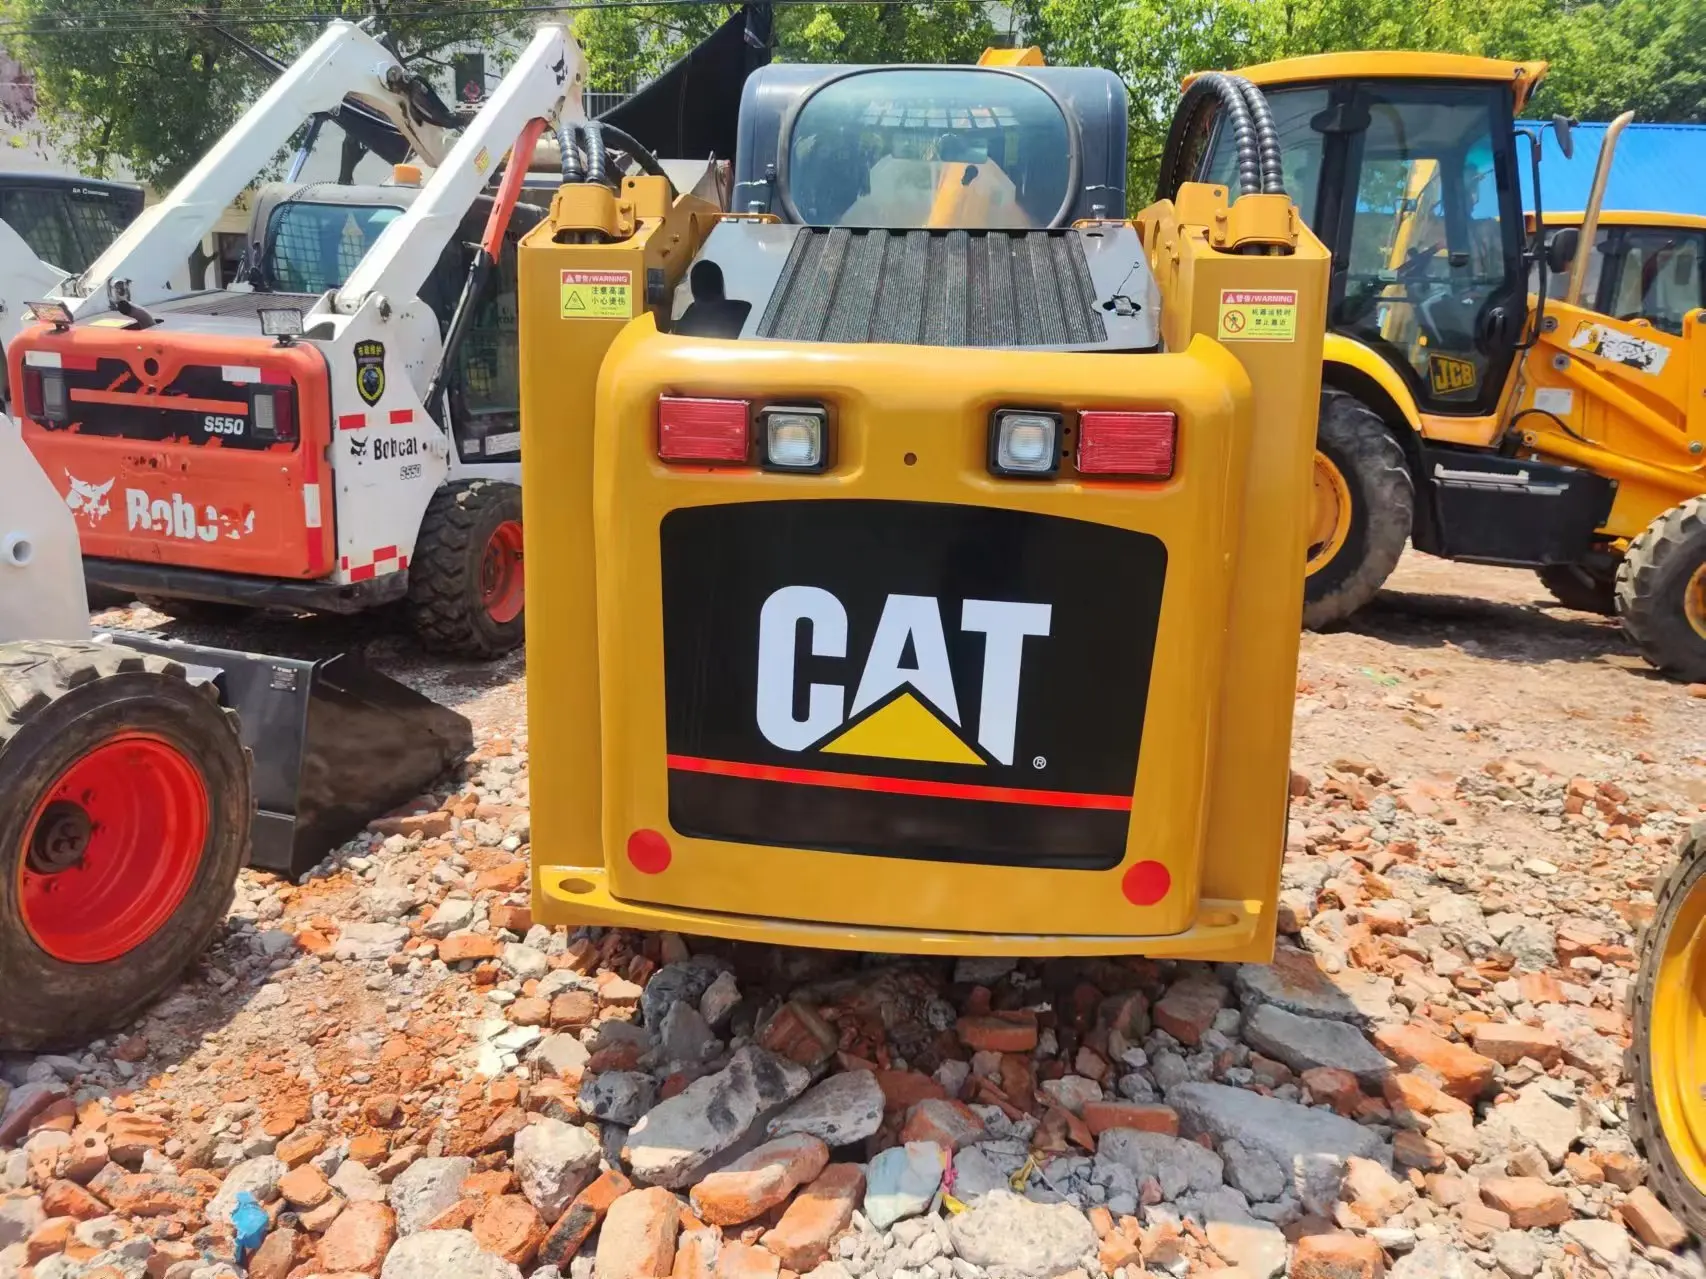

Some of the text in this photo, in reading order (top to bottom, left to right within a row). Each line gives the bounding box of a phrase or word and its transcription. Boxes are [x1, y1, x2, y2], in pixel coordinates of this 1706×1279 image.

[591, 286, 625, 295] 注意高温
[1435, 359, 1473, 390] JCB
[204, 415, 244, 435] S550
[373, 436, 418, 461] Bobcat
[756, 585, 1052, 766] CAT
